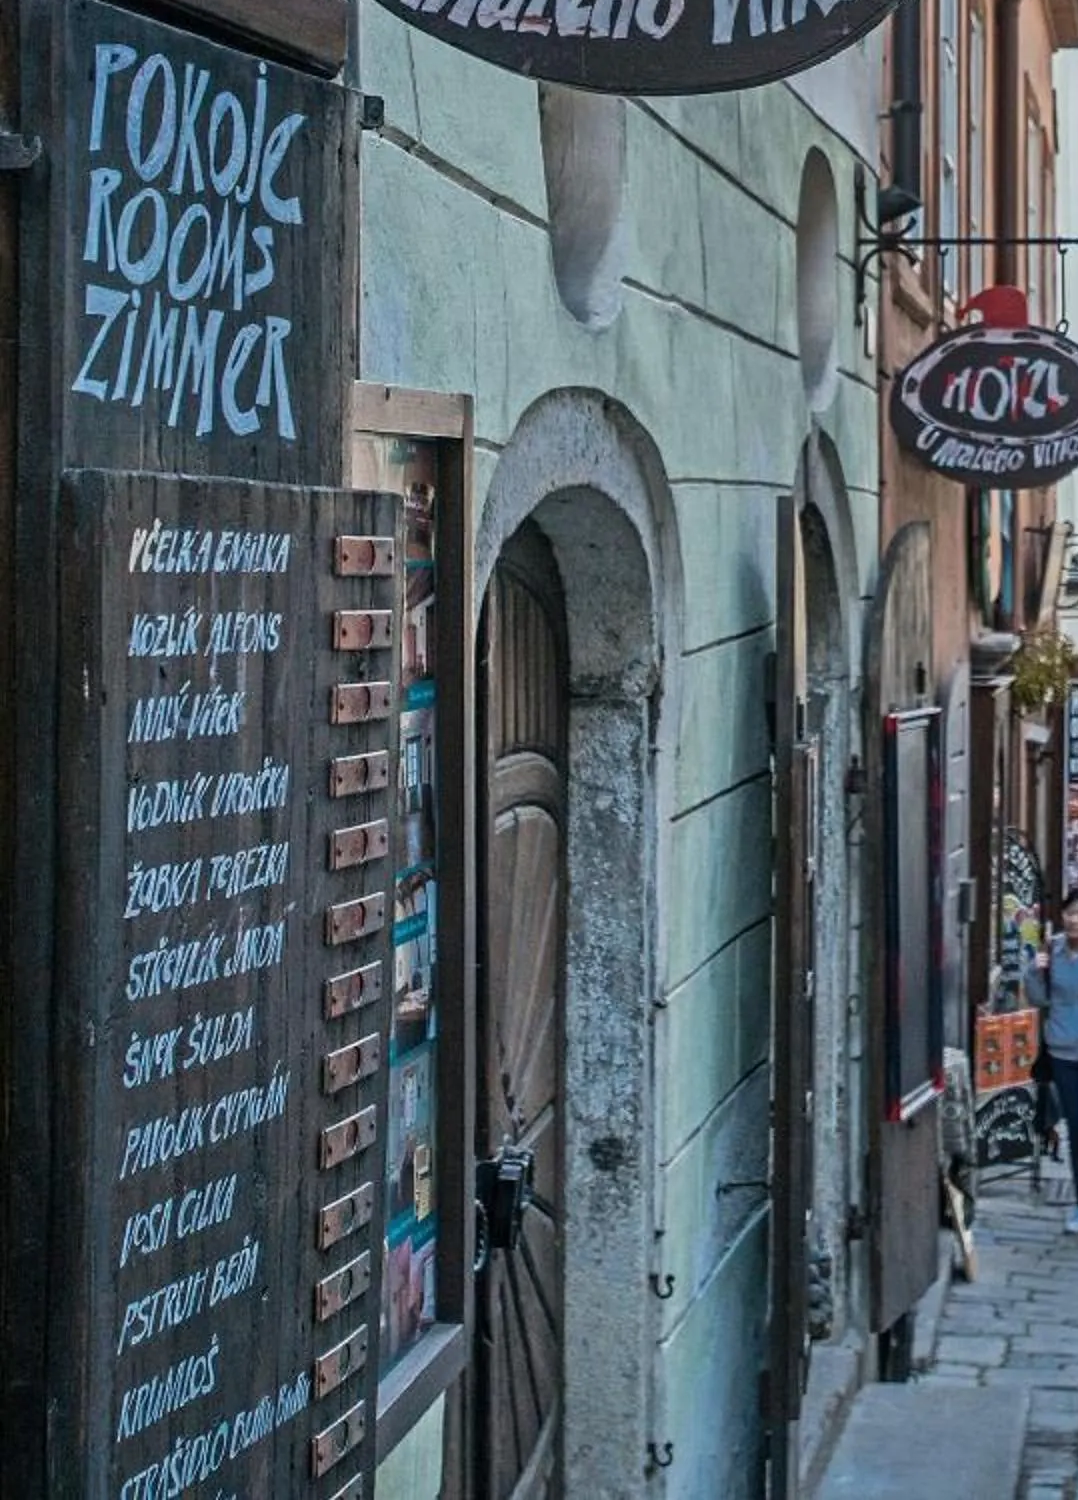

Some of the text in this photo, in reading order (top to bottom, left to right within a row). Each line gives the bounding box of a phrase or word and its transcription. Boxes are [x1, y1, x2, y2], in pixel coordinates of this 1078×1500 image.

[88, 42, 305, 225] POKOJE
[82, 167, 275, 311] ROOMS
[71, 283, 298, 442] ZIMMER
[915, 423, 941, 451] U
[203, 610, 283, 657] ALFONS
